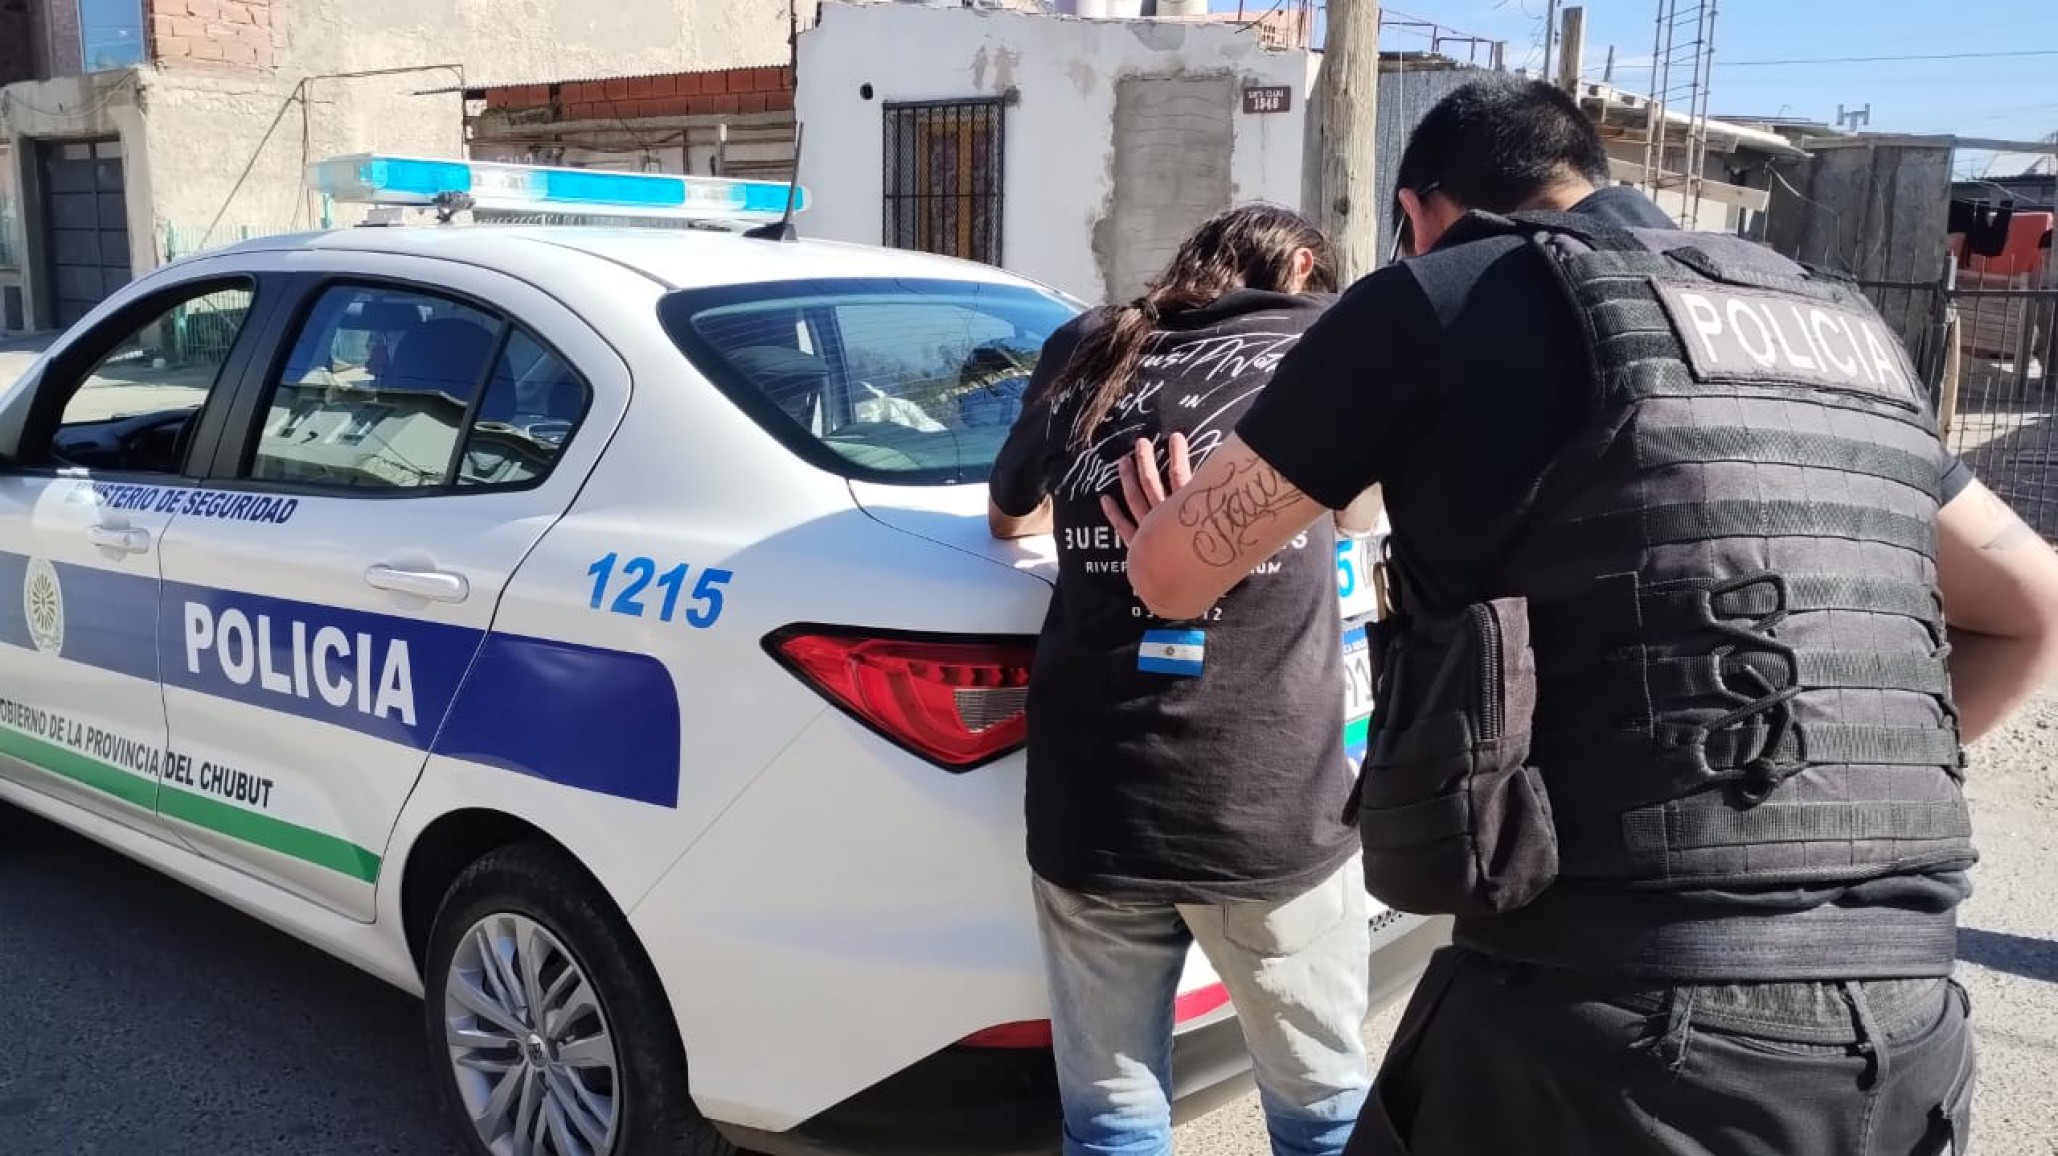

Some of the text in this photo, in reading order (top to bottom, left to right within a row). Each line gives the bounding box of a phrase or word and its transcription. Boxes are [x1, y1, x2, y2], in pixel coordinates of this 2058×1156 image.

[1680, 293, 1907, 385] POLICIA
[154, 489, 186, 512] DE
[181, 492, 298, 524] SEGURIDAD
[587, 552, 733, 628] 1215
[184, 601, 417, 725] POLICIA
[0, 698, 273, 808] OBIERNO DE LA PROVINCIA DEL CHUBUT
